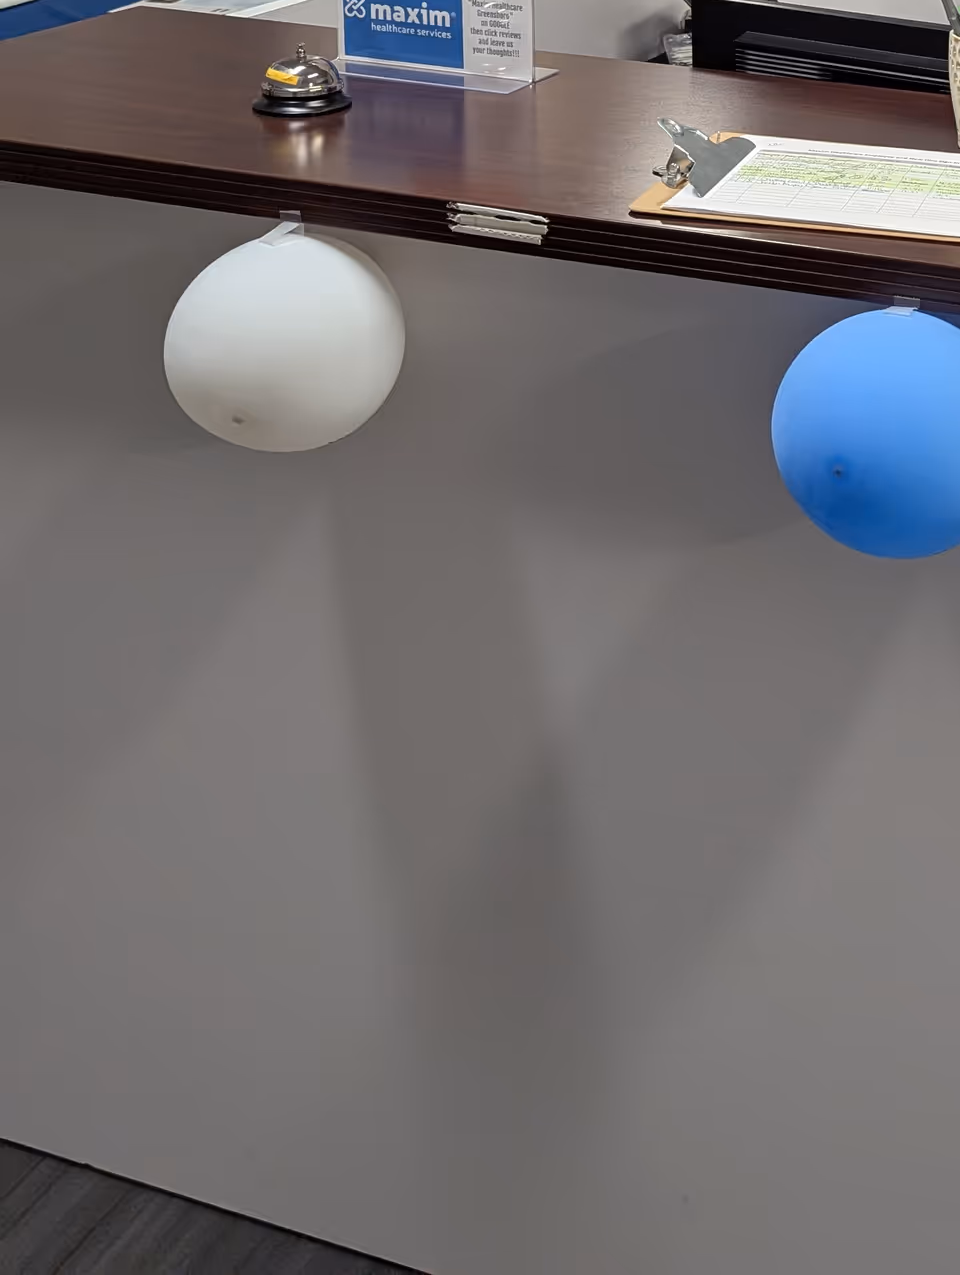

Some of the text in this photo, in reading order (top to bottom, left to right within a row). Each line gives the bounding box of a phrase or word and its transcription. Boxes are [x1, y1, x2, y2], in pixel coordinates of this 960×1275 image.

[370, 2, 451, 27] maxim
[371, 22, 452, 39] healthcare services
[470, 27, 483, 35] then
[484, 29, 497, 37] click
[472, 47, 485, 55] your
